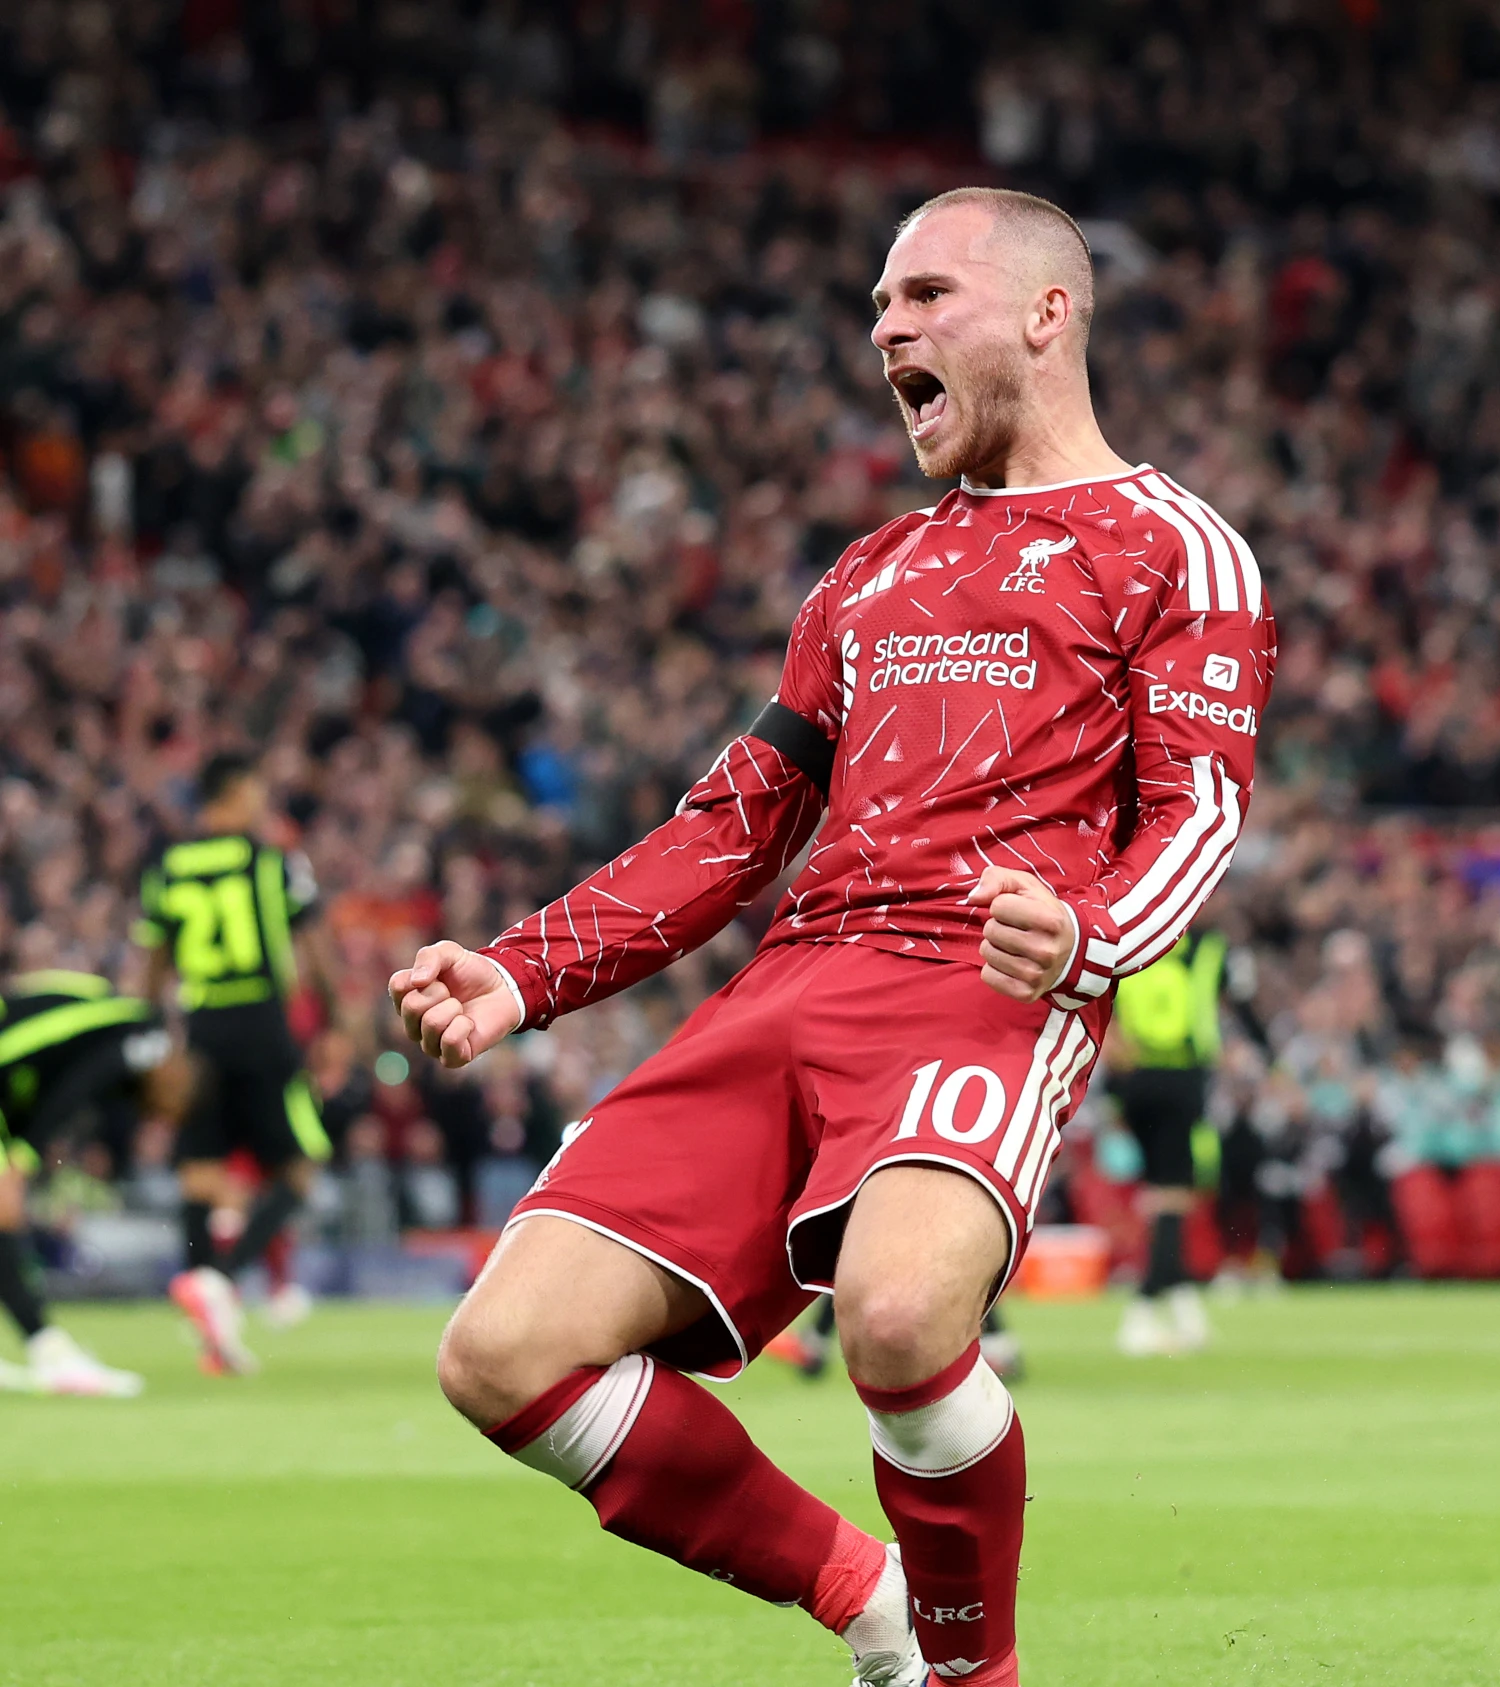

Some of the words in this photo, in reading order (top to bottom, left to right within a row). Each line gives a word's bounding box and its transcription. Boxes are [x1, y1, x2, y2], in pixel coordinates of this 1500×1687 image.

[873, 626, 1029, 663] standard
[869, 656, 1037, 692] chartered
[1148, 684, 1257, 737] Expedi
[160, 874, 262, 978] 21
[890, 1060, 1007, 1144] 10
[913, 1596, 984, 1624] LFC
